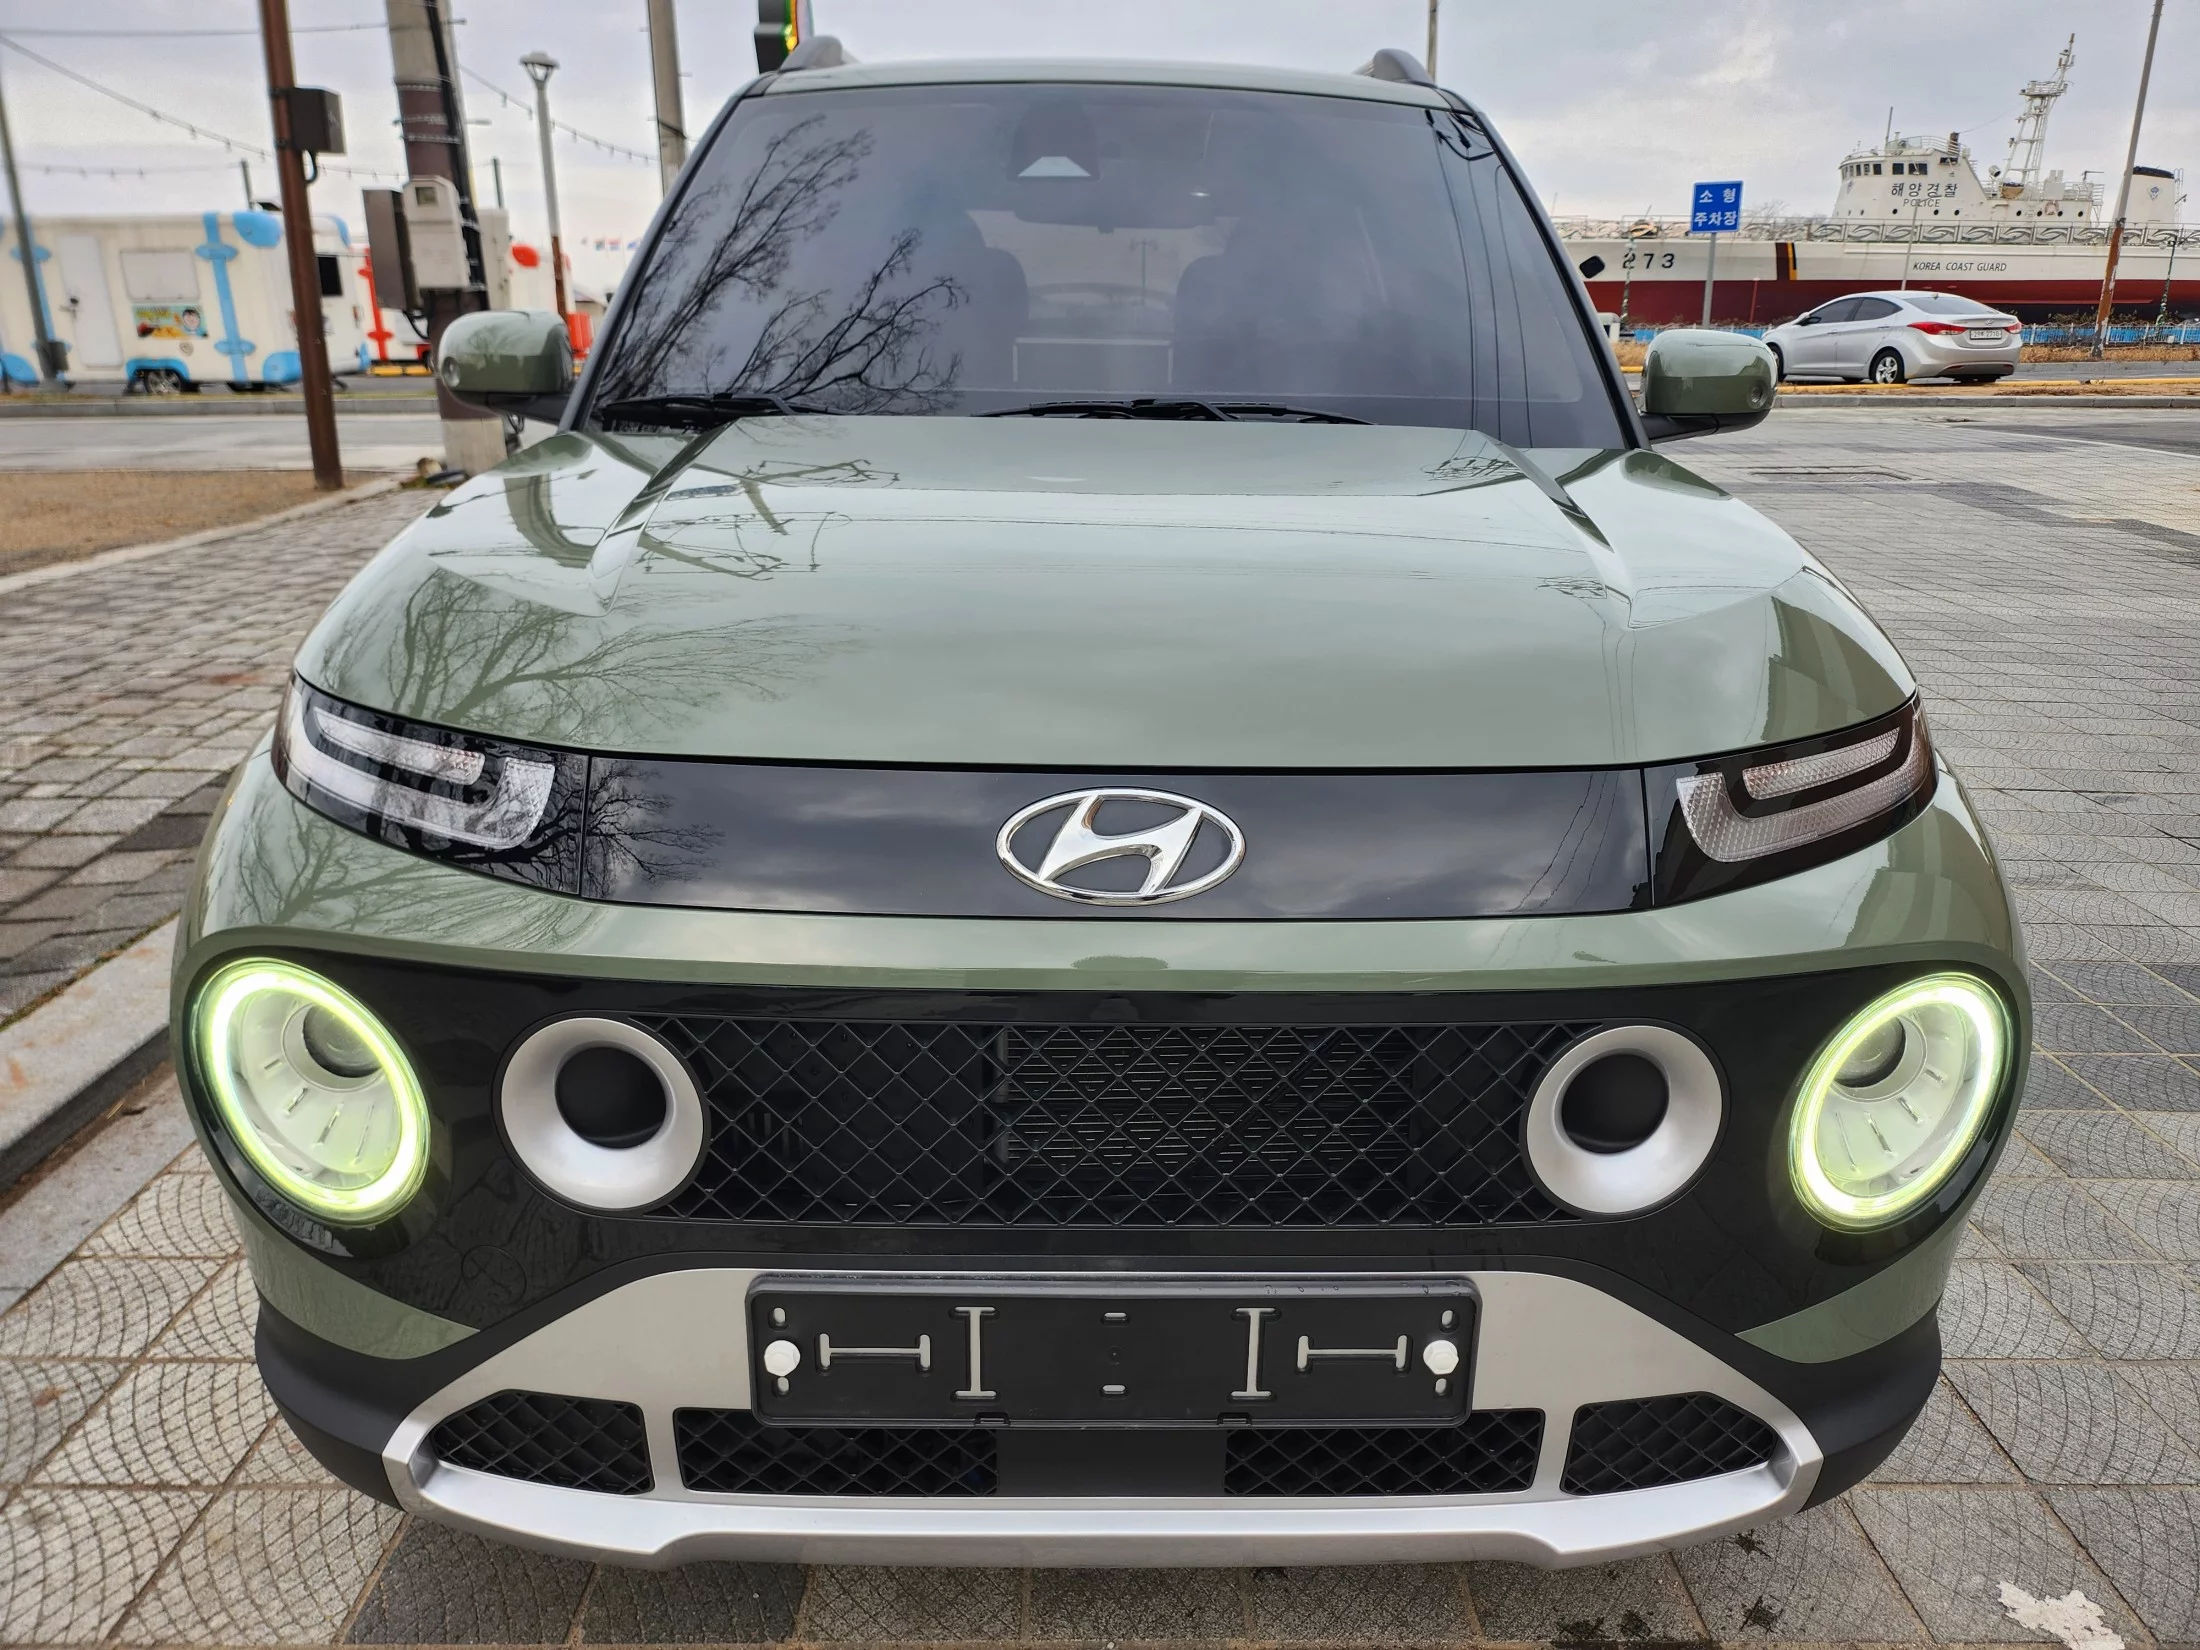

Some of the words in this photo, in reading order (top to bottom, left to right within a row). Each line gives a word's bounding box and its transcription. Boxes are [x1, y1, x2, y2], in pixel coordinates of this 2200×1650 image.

[1891, 182, 1958, 198] 해양경찰
[1902, 198, 1941, 208] POLICE
[1693, 211, 1738, 228] 주차장
[1912, 261, 1941, 271] KOREA
[1945, 262, 1974, 272] COAST
[1976, 262, 2007, 272] GUARD
